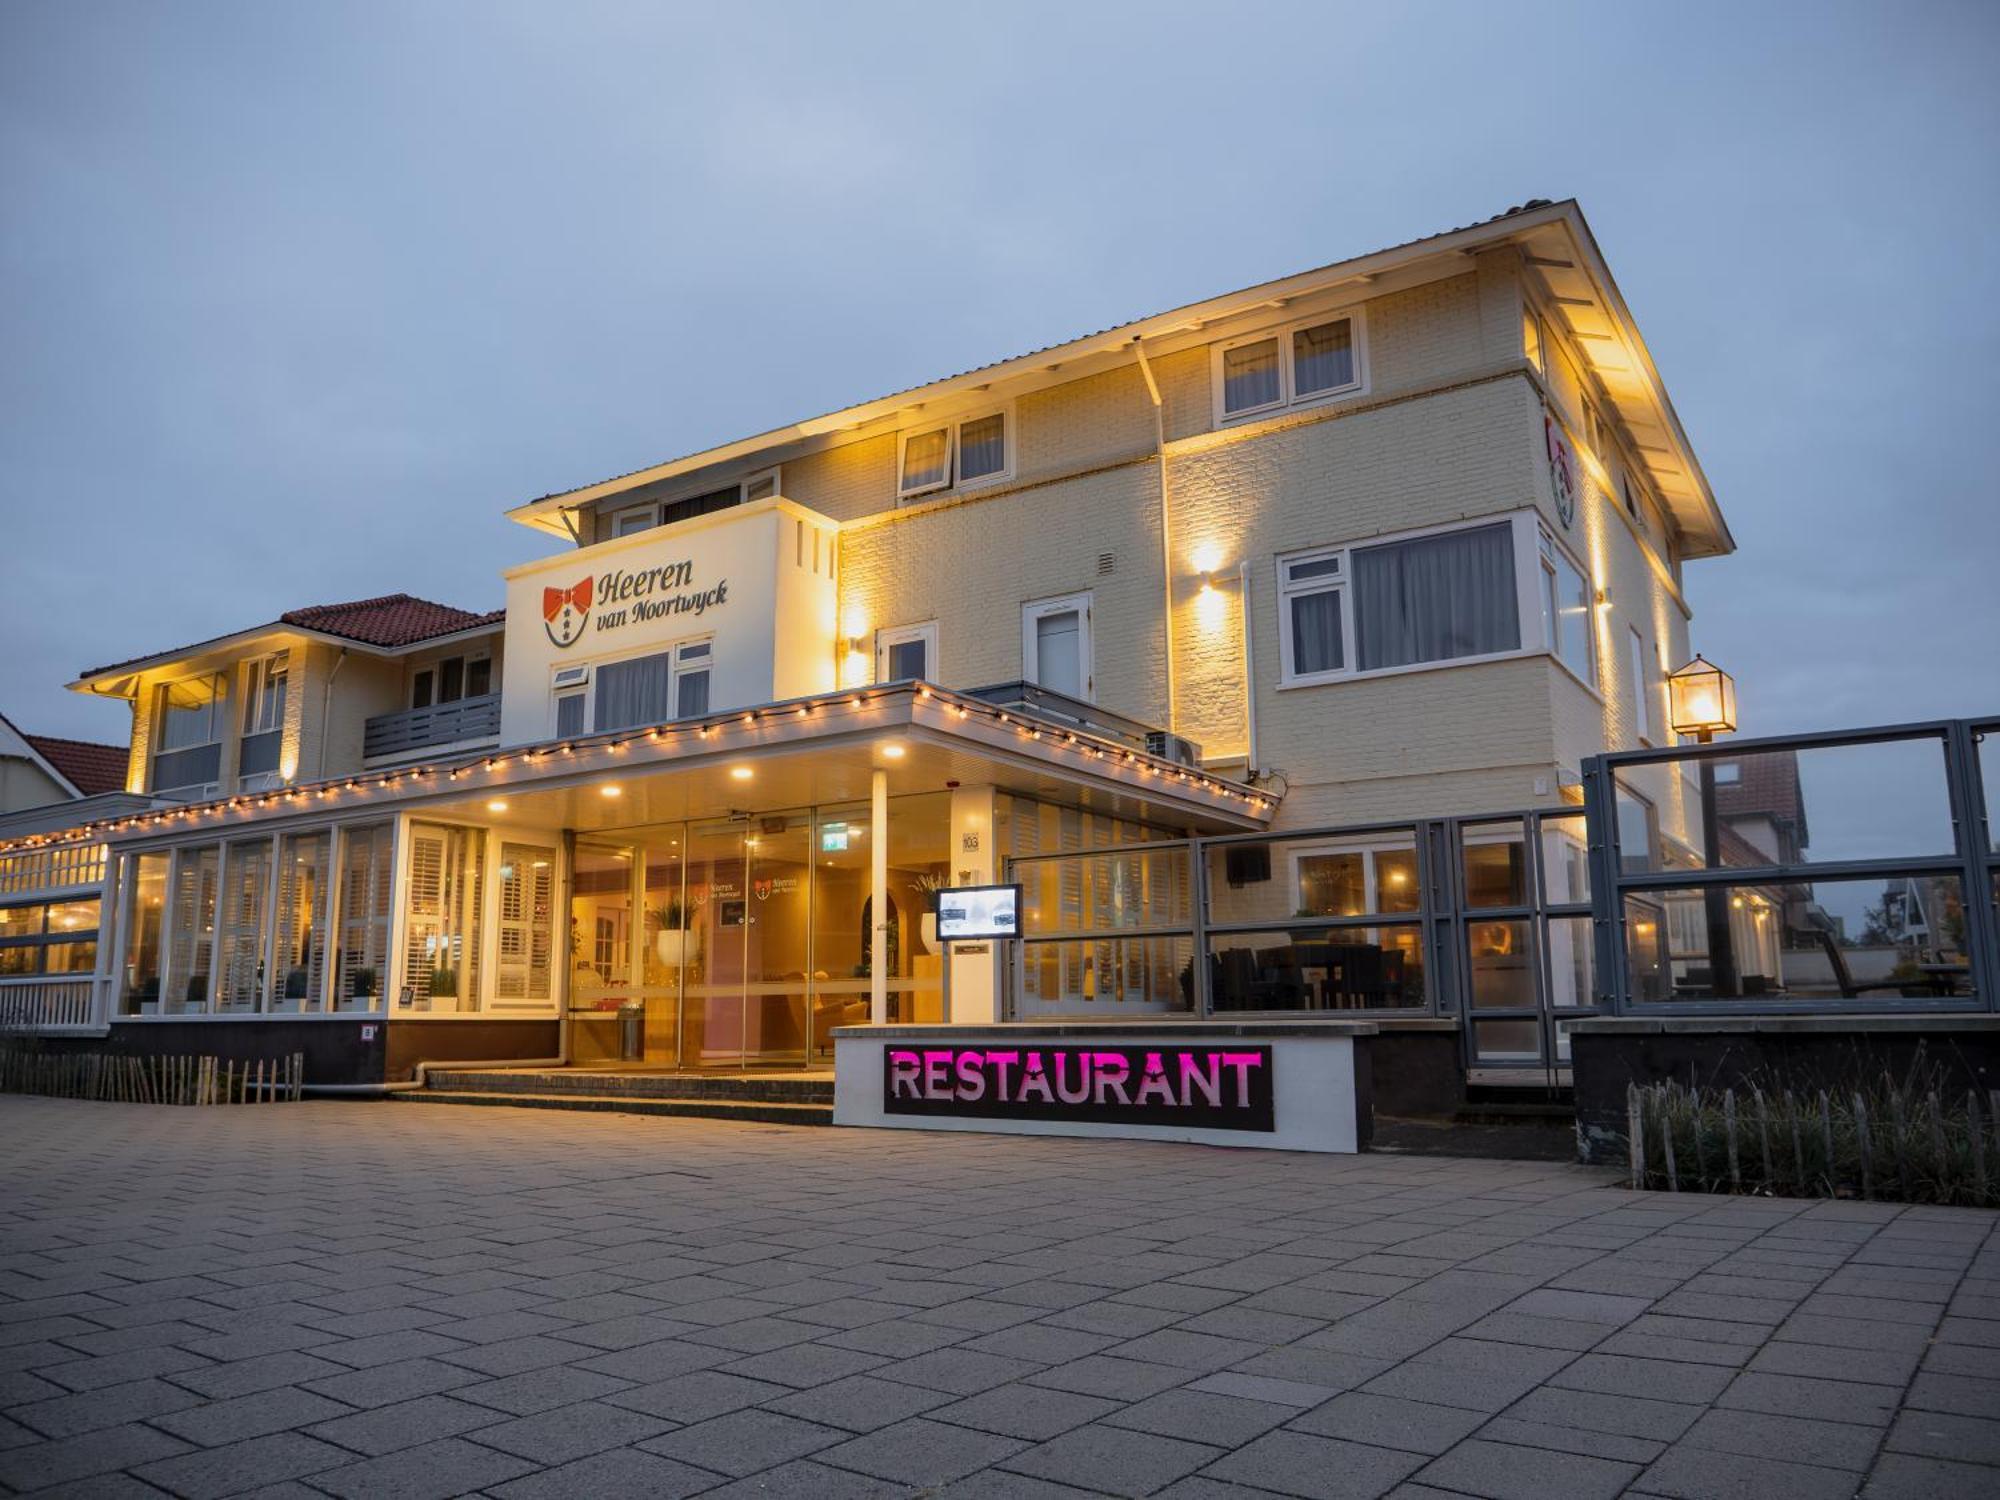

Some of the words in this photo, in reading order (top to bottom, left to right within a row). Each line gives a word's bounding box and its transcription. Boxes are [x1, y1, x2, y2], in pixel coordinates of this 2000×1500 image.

[596, 608, 627, 632] van
[631, 579, 729, 623] Noortwyck
[598, 560, 692, 605] Heeren
[889, 1050, 1263, 1108] RESTAURANT
